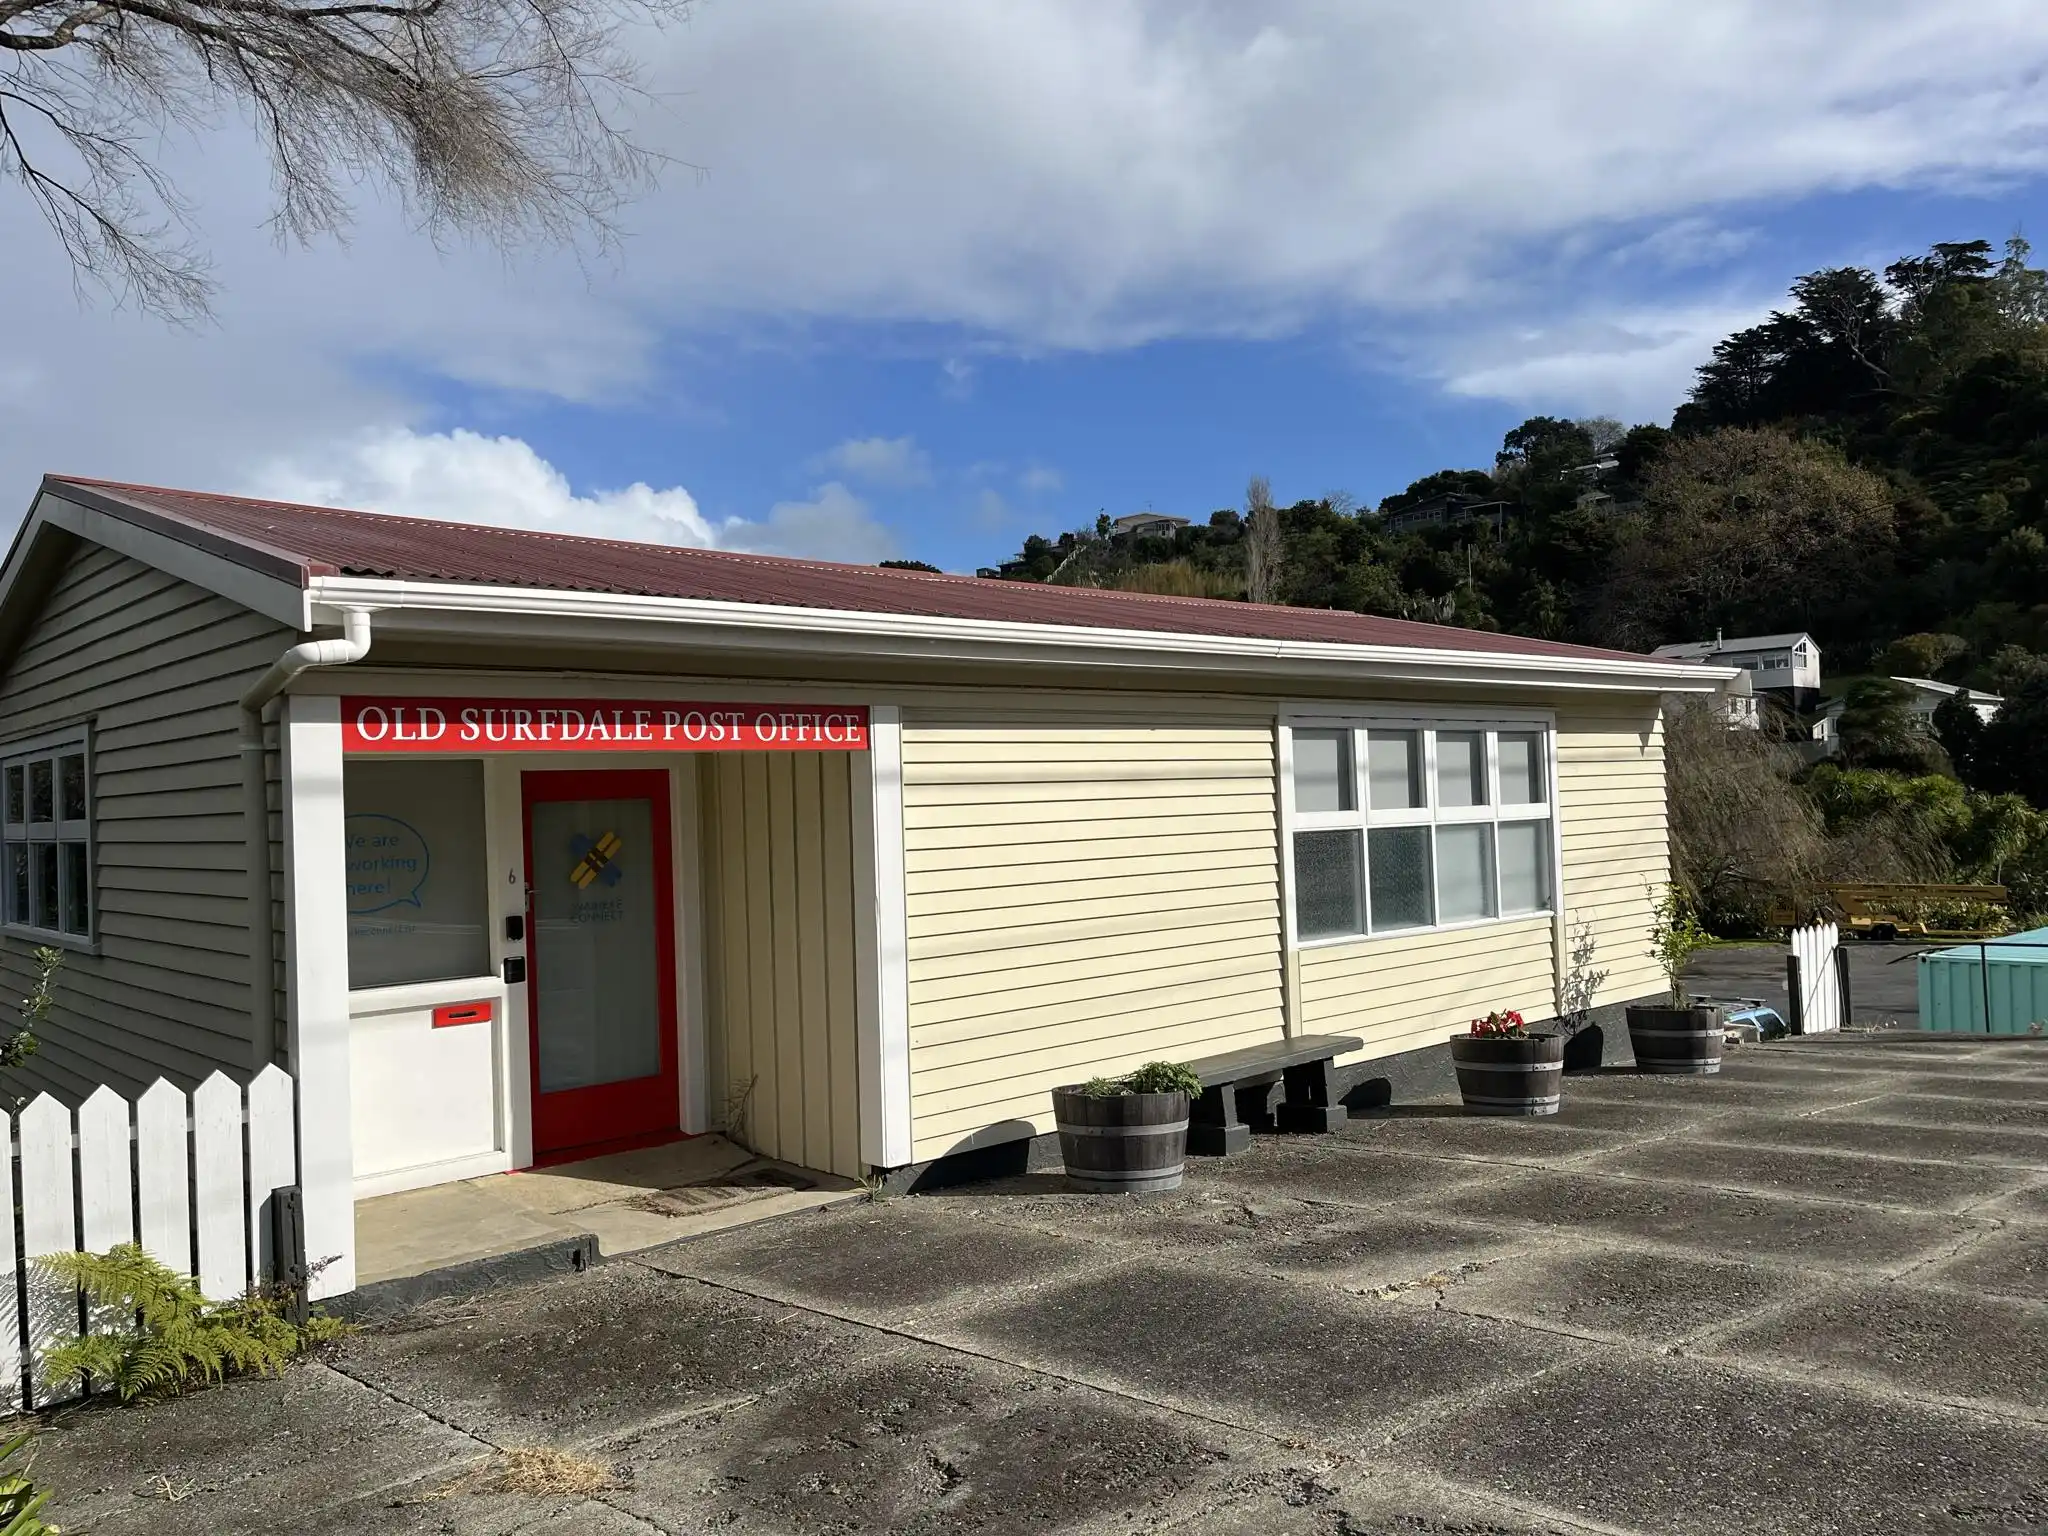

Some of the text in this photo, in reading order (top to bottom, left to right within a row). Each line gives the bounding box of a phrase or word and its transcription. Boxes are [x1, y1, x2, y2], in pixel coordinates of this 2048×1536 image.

[356, 706, 861, 742] OLD SURFDALE POST OFFICE
[371, 835, 400, 848] are
[508, 867, 516, 885] 6
